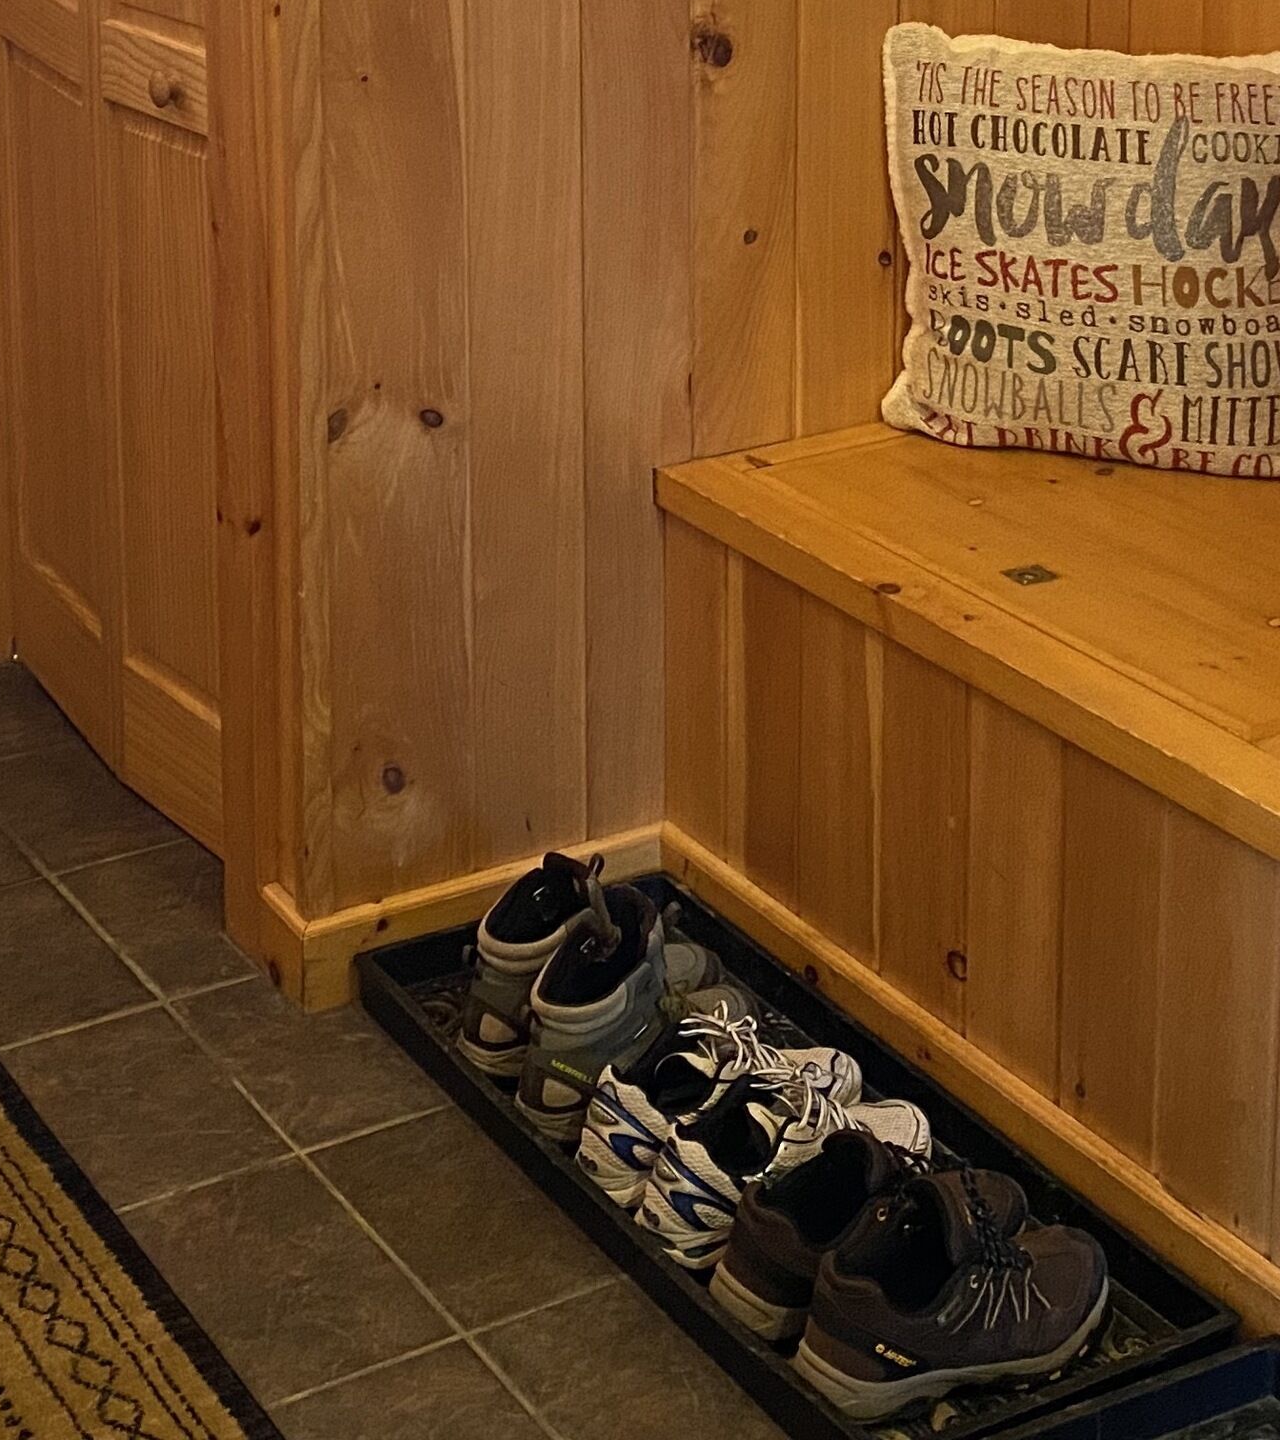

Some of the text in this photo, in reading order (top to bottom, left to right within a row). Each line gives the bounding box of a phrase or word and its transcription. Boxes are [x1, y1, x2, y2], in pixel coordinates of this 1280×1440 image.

[917, 60, 947, 104] 'TIS
[961, 66, 1003, 108] THE
[1016, 74, 1116, 120] SEASON
[1128, 81, 1161, 124] TO
[1173, 81, 1204, 124] BE
[912, 109, 959, 147] HOT
[970, 113, 1153, 165] CHOCOLATE
[924, 243, 966, 282] ICE
[975, 249, 1119, 304] SKATES
[928, 283, 990, 312] skis
[1015, 299, 1099, 328] sled
[930, 308, 1057, 376] BOOTS
[1072, 335, 1192, 387] SCARF
[922, 347, 1118, 433] SNOWBALLS
[1117, 389, 1173, 466] &
[994, 425, 1115, 459] DRINK
